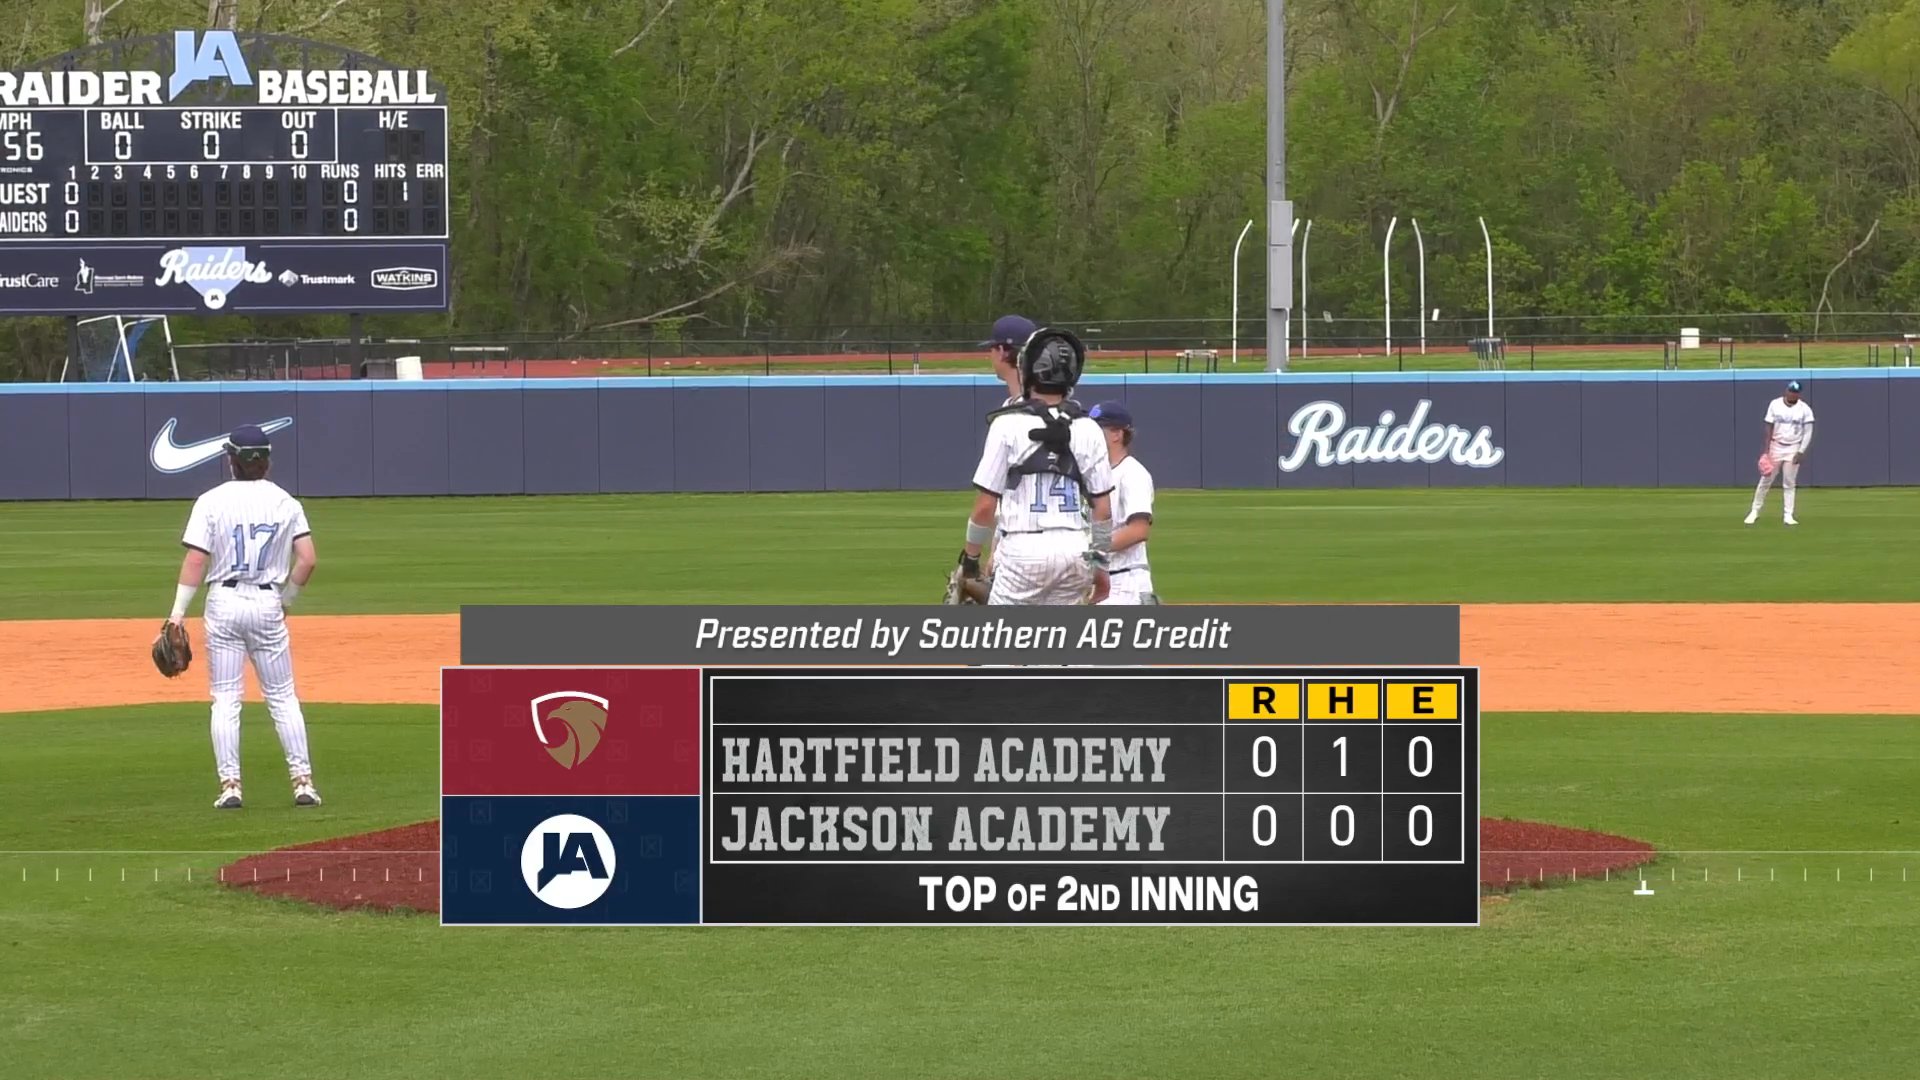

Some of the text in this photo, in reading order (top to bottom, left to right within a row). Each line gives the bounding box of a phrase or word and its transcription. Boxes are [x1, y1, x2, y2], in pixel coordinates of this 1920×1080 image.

[168, 30, 253, 101] JA
[259, 70, 436, 103] BASEBALL
[101, 112, 144, 129] BALL
[181, 112, 241, 129] STRIKE
[282, 111, 317, 128] OUT
[379, 111, 408, 130] H/E
[5, 132, 43, 160] 56
[115, 131, 131, 159] 0
[204, 131, 219, 159] 0
[292, 131, 307, 158] 0
[69, 164, 443, 180] 1 2 3 4 5 6 7 8 9 10 RUNS HITS ERR
[0, 183, 50, 204] UEST
[65, 182, 78, 204] 0
[344, 180, 357, 203] 0
[0, 208, 357, 232] AIDERS 0 0
[0, 273, 59, 287] rustCare
[155, 248, 272, 287] Raiders
[300, 274, 355, 284] Trustmark
[376, 273, 433, 282] WATKINS
[1278, 399, 1505, 472] Raiders
[1029, 473, 1081, 512] 14
[231, 523, 280, 571] 17
